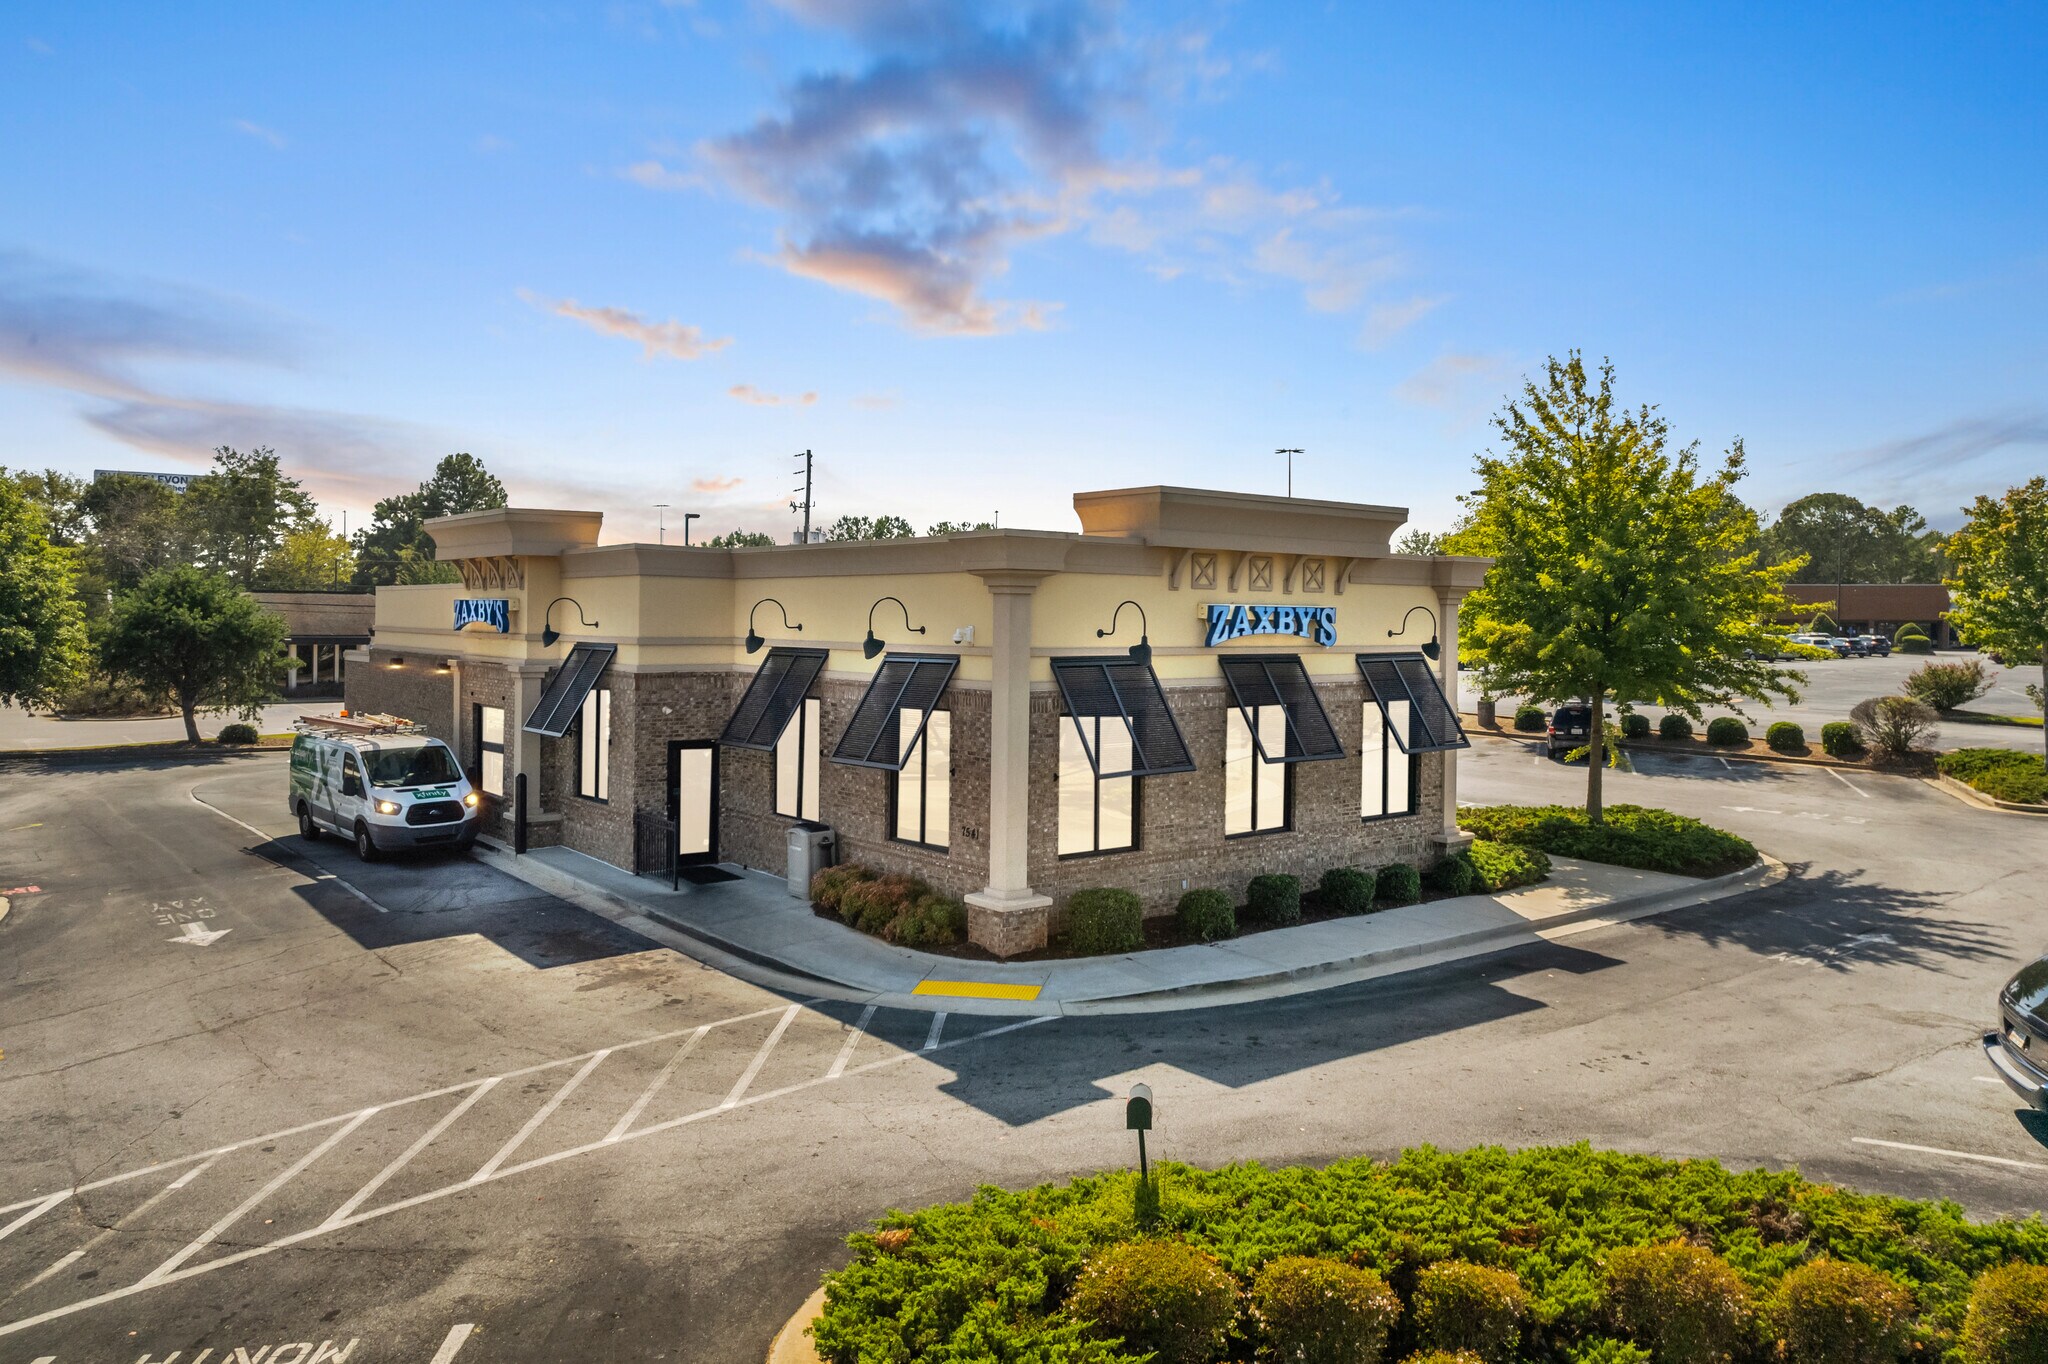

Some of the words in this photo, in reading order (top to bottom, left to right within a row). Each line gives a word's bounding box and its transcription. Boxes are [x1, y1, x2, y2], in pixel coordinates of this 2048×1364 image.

[152, 474, 188, 485] EVON
[453, 599, 507, 633] ZAXBY'S
[1205, 604, 1337, 648] ZAXBY'S
[416, 790, 447, 799] xfinity
